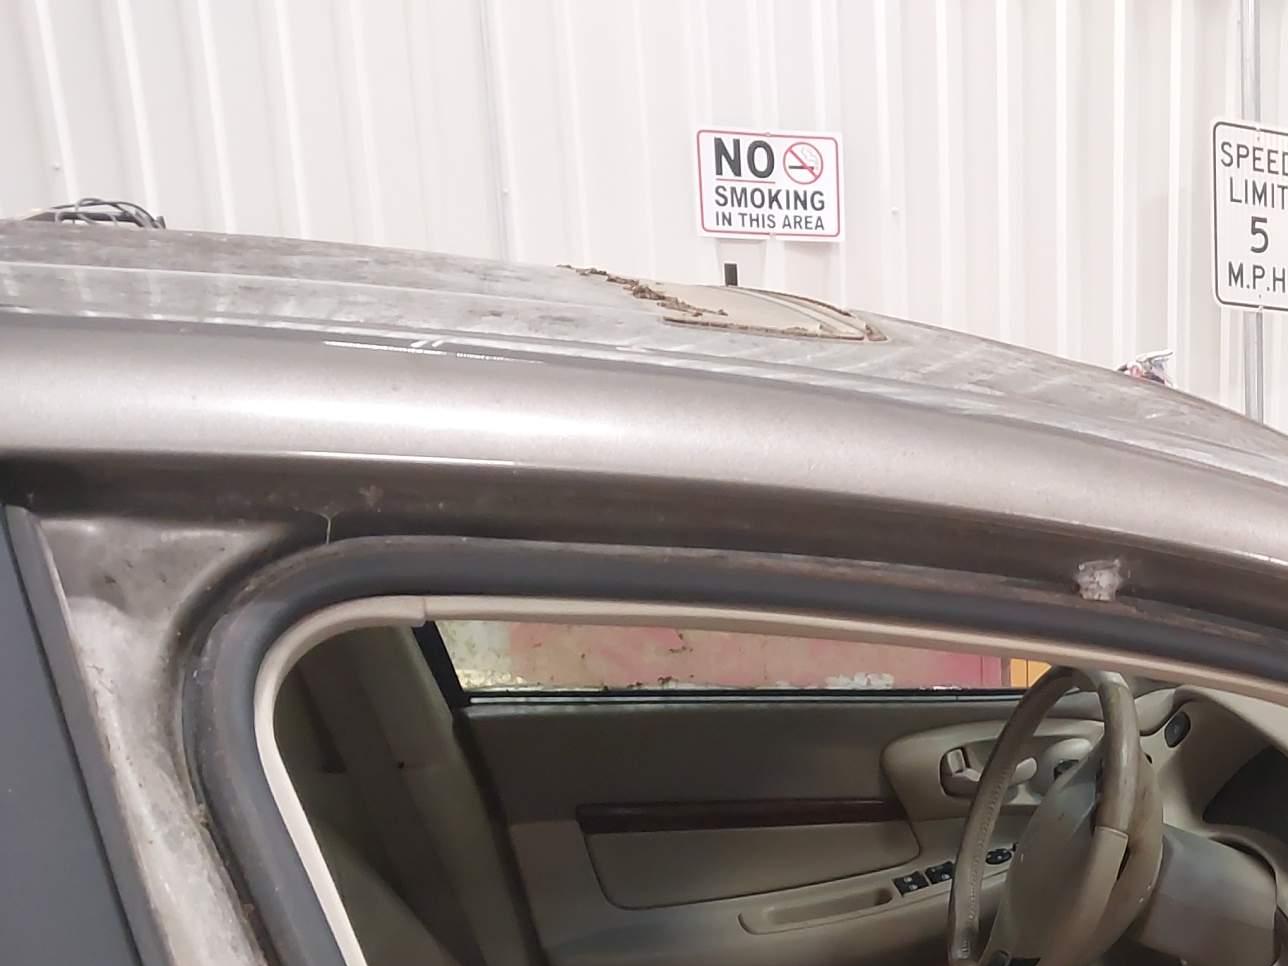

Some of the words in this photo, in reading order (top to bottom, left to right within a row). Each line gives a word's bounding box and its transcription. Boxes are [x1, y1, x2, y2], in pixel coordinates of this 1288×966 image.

[713, 136, 775, 179] NO
[714, 185, 826, 212] SMOKING
[1229, 176, 1288, 210] LIMIT
[715, 211, 733, 227] IN
[738, 212, 777, 229] THIS
[781, 214, 825, 231] AREA
[1249, 215, 1269, 254] 5
